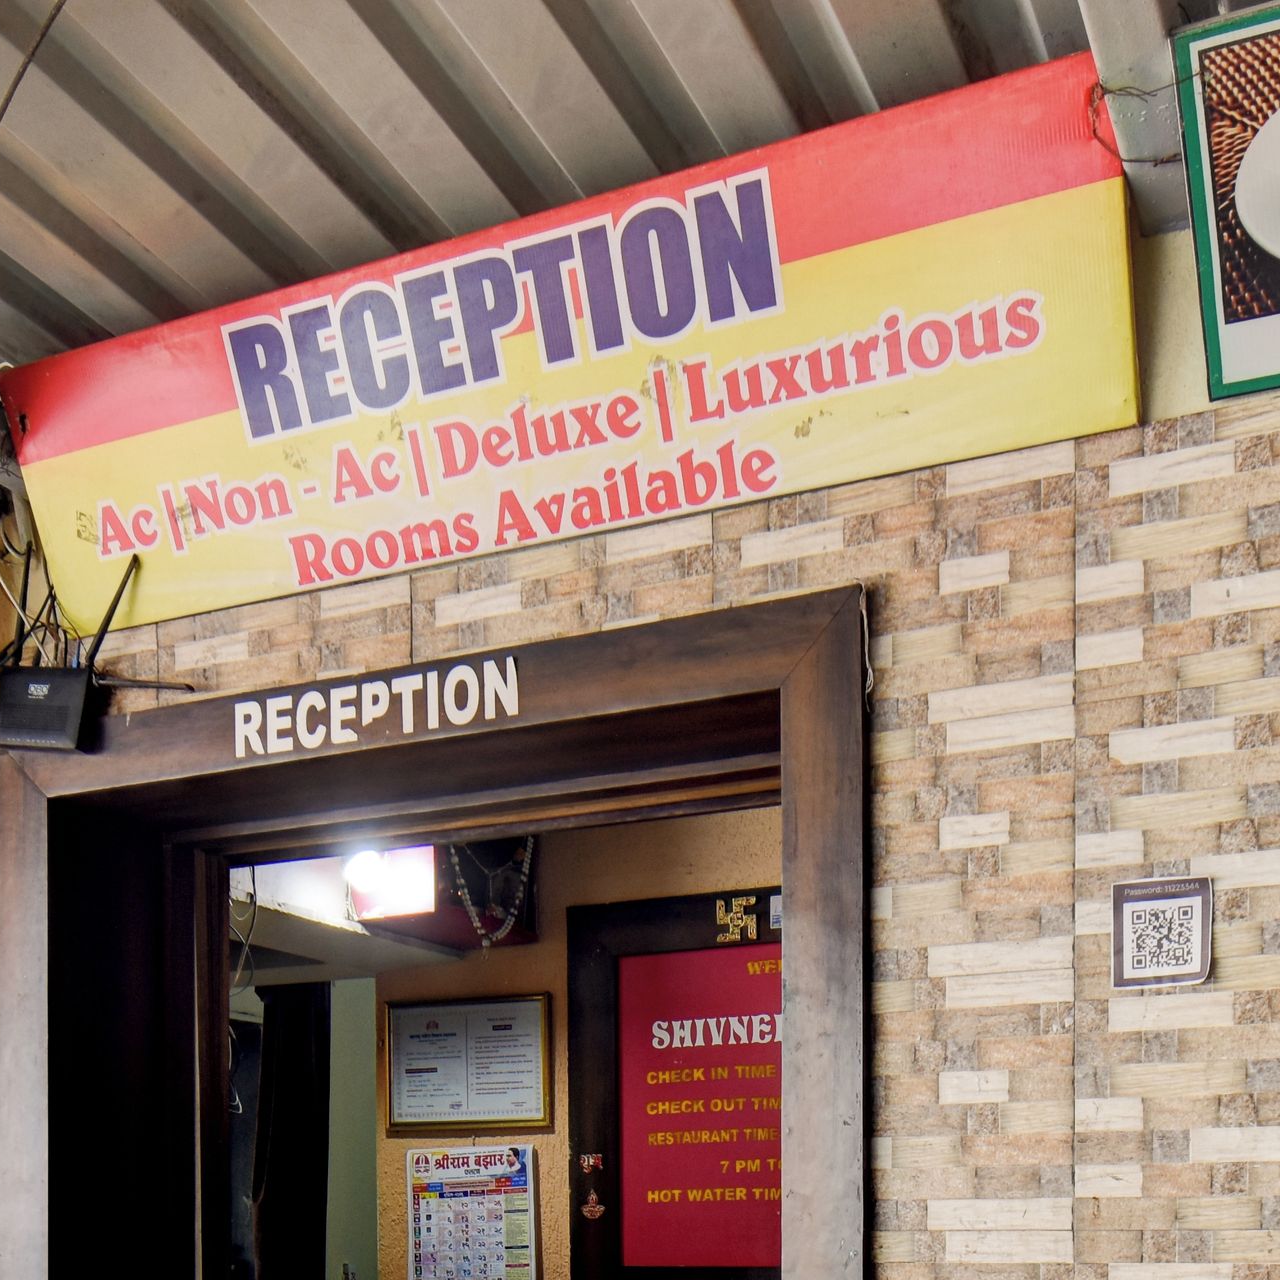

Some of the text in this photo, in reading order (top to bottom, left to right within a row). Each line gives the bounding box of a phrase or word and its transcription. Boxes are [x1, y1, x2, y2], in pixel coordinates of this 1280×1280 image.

[228, 178, 778, 439] RECEPTION
[682, 297, 1041, 423] Luxurious
[288, 439, 777, 586] Rooms Available
[234, 656, 519, 758] RECEPTION
[646, 1064, 777, 1085] CHECK IN TIME
[646, 1099, 705, 1115] CHECK
[710, 1097, 747, 1112] OUT
[648, 1129, 739, 1146] RESTAURANT
[434, 1153, 470, 1170] श्रीराम
[720, 1160, 730, 1174] 7
[735, 1158, 761, 1173] PM
[647, 1189, 682, 1203] HOT
[687, 1187, 747, 1202] WATER
